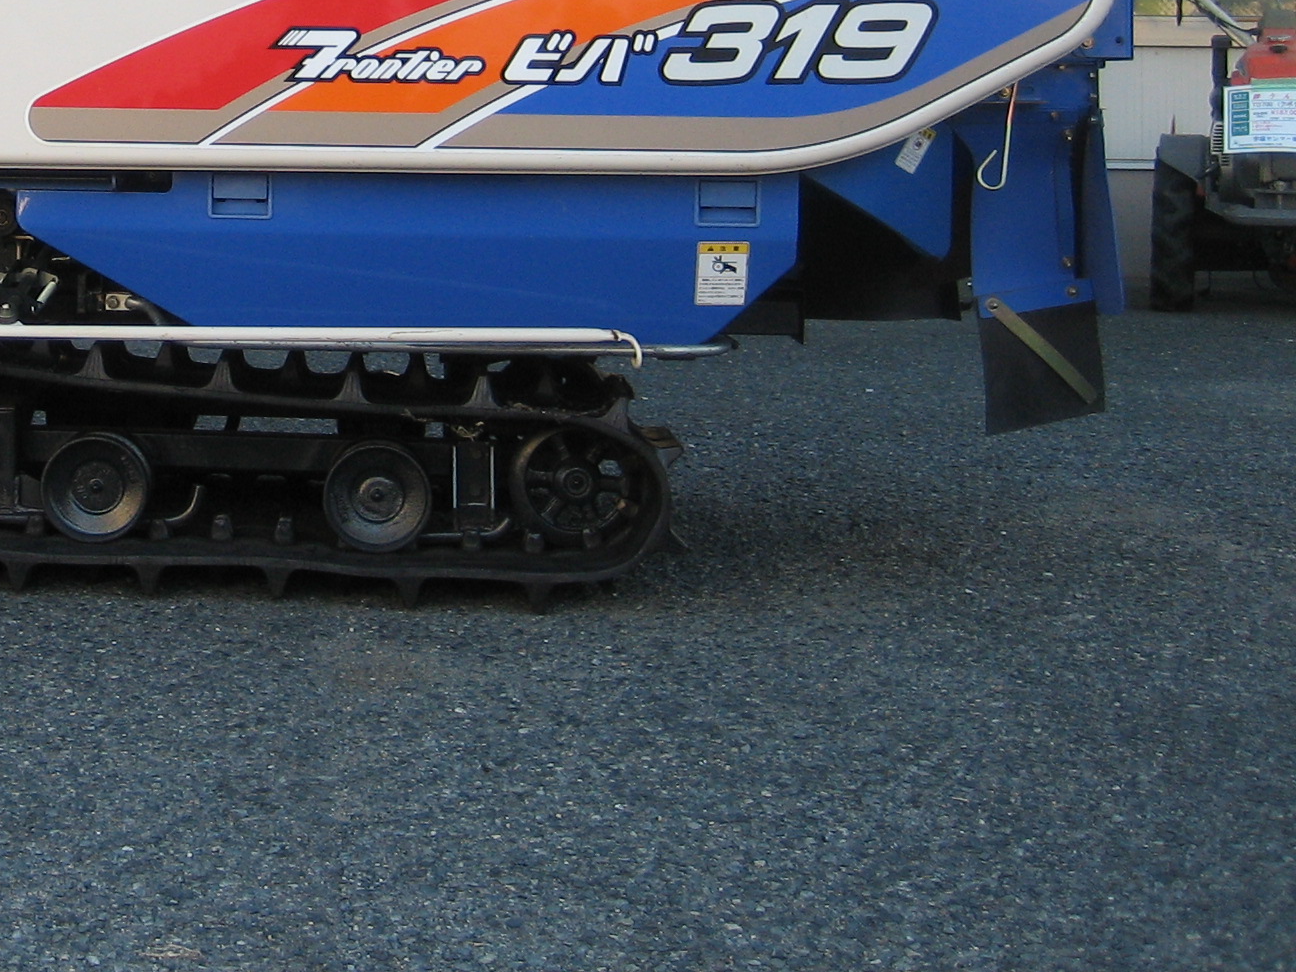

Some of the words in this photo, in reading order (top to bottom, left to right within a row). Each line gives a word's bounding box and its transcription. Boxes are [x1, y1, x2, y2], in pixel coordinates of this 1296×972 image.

[277, 28, 486, 83] Frontier
[503, 30, 655, 83] ビバ
[663, 1, 936, 84] 319
